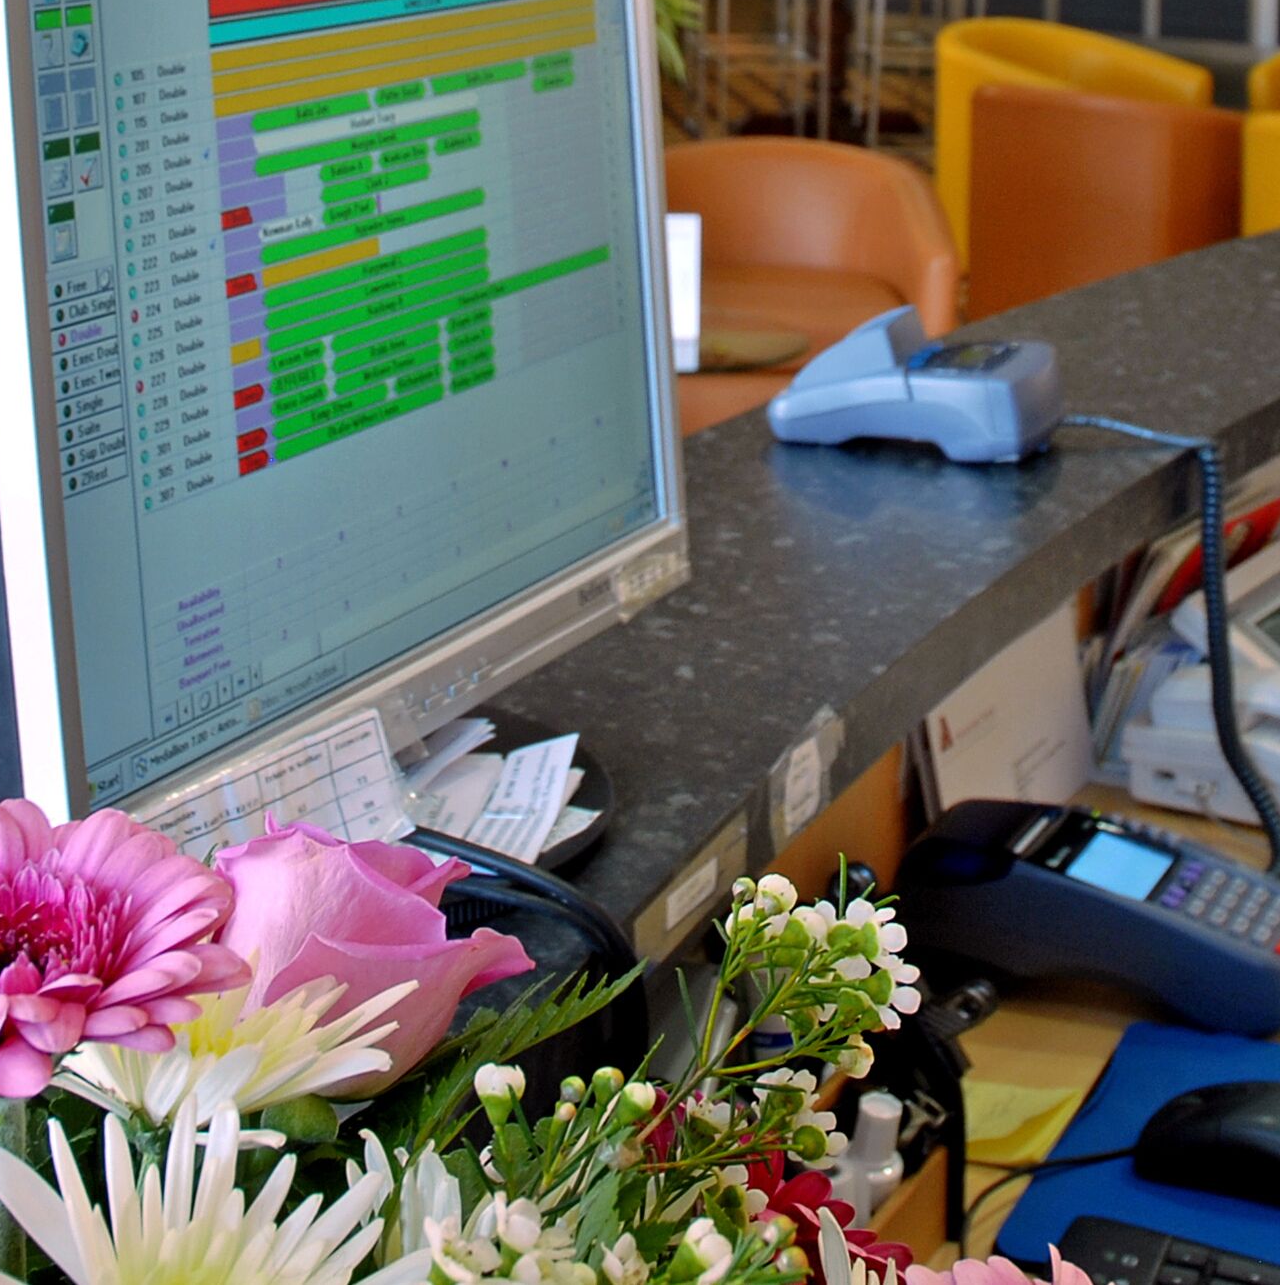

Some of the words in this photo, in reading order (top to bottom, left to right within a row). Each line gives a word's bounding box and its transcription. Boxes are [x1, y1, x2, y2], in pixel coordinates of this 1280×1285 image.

[157, 62, 185, 76] Double
[159, 86, 186, 100] Double
[160, 109, 188, 123] Double
[162, 132, 189, 146] Double
[163, 155, 191, 170] Double
[165, 178, 193, 192] Double
[167, 201, 194, 216] Double
[168, 224, 196, 239] Double
[142, 256, 157, 269] 222
[170, 247, 197, 262] Double
[67, 278, 87, 293] Free
[171, 269, 199, 286] Double
[69, 302, 88, 318] Club
[145, 303, 160, 316] 224
[173, 292, 201, 309] Double
[71, 324, 101, 341] Double
[147, 326, 162, 340] 225
[175, 315, 202, 332] Double
[176, 337, 204, 354] Double
[72, 350, 94, 366] Exec
[74, 373, 96, 389] Exec
[150, 372, 165, 386] 227
[178, 360, 205, 377] Double
[180, 383, 207, 400] Double
[76, 394, 103, 415] Single
[181, 406, 208, 423] Double
[78, 420, 100, 437] Suite
[183, 428, 210, 446] Double
[79, 445, 97, 462] Sup
[185, 451, 212, 469] Double
[186, 473, 214, 492] Double
[149, 740, 190, 766] Medallion
[98, 773, 120, 792] Start
